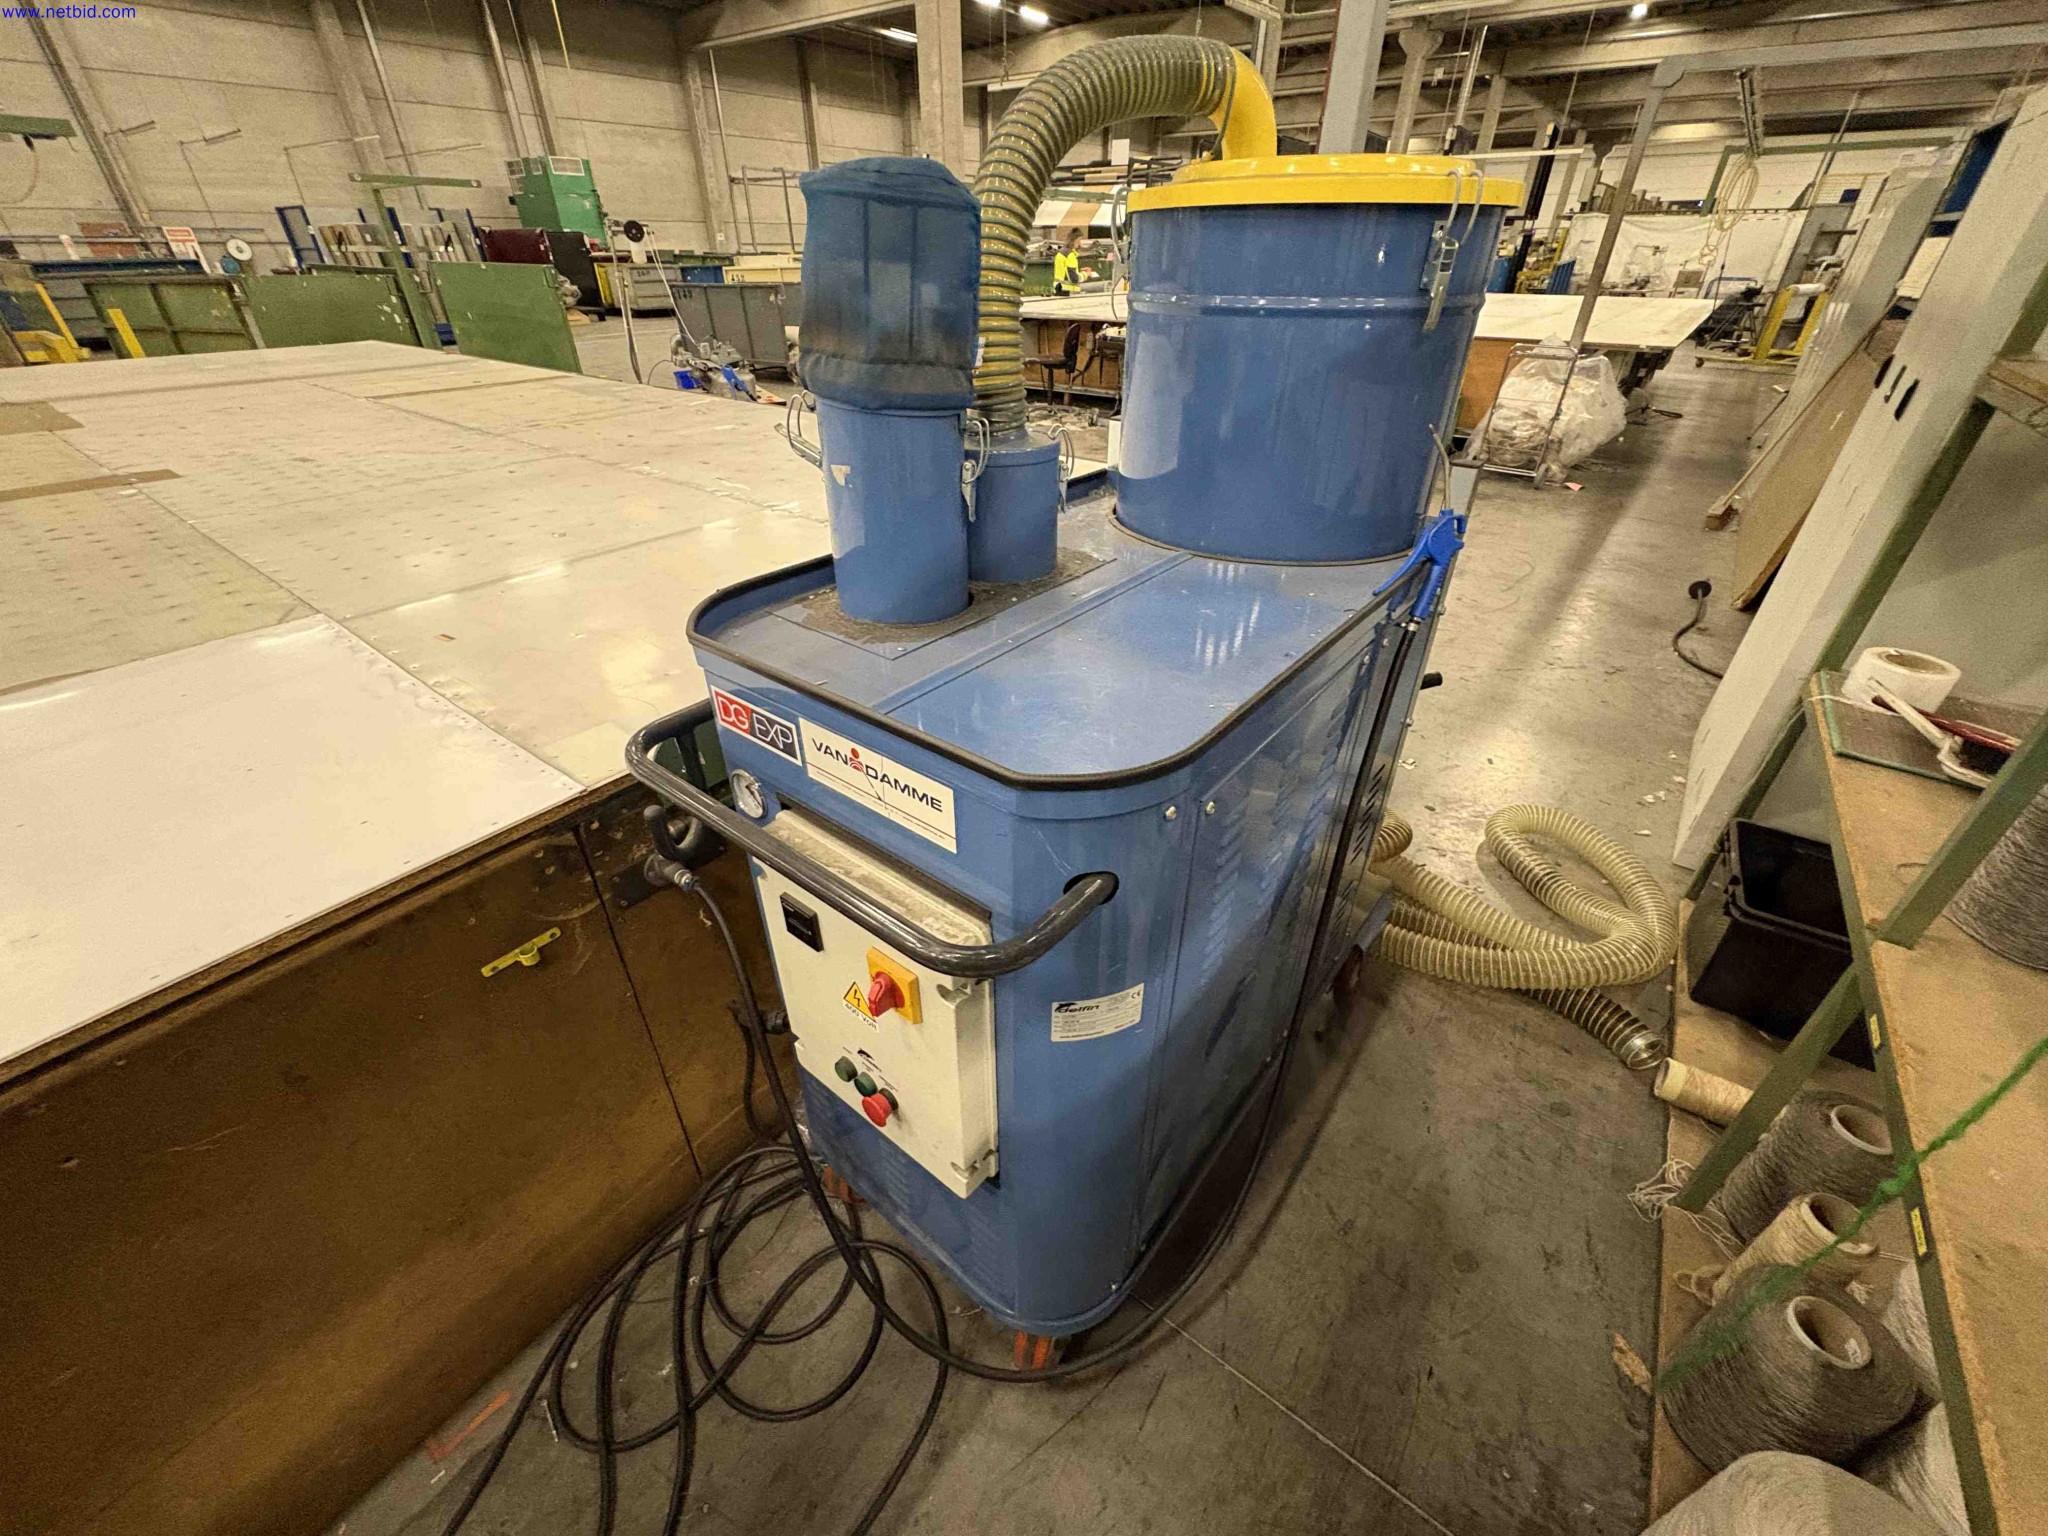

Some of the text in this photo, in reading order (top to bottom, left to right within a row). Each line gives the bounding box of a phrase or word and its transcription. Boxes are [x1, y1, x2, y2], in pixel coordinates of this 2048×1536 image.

[717, 694, 793, 750] DG EXP
[811, 737, 849, 766] VAN
[864, 763, 944, 813] DAMME
